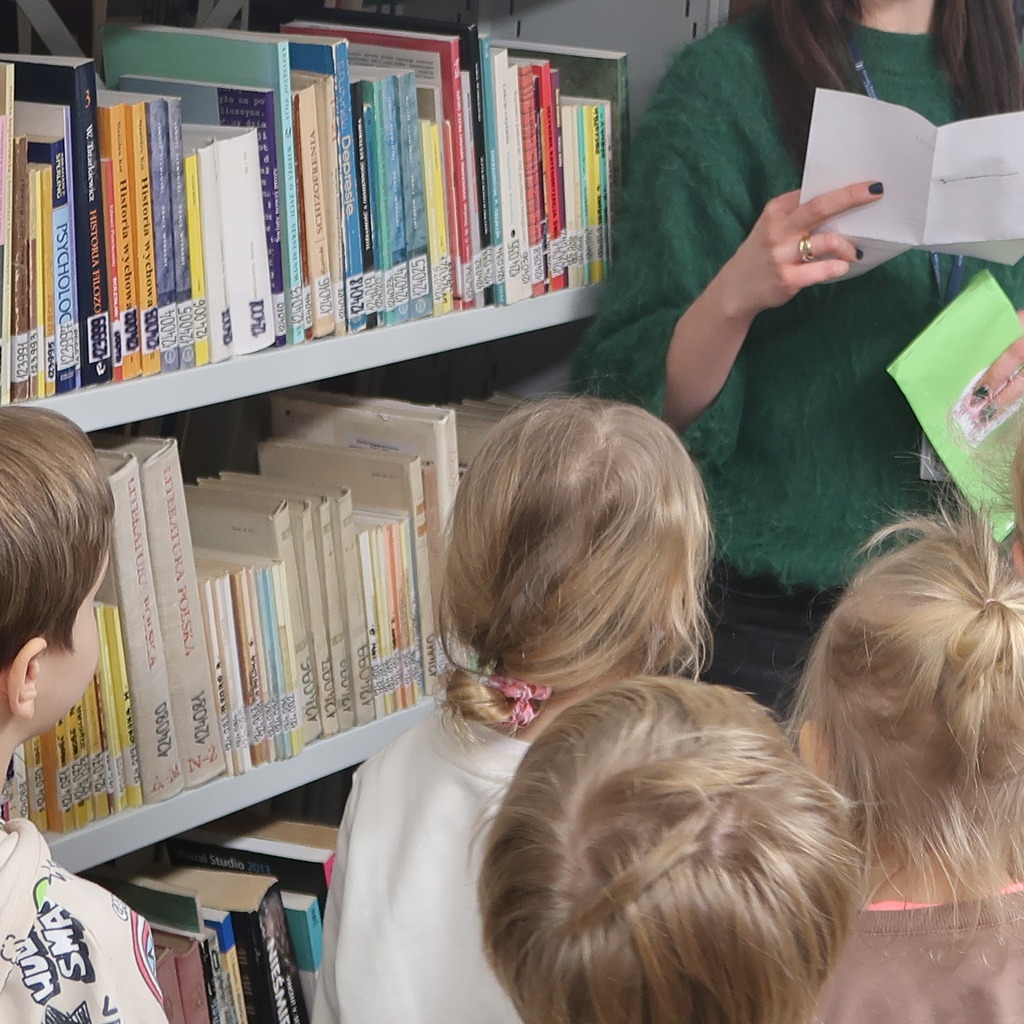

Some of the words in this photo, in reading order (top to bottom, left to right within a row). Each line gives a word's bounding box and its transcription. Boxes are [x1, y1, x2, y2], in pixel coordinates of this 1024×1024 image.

[55, 152, 63, 199] SPERLING
[86, 139, 95, 202] Tatarkiewicz
[308, 129, 323, 235] SCHIZOFRENIA
[340, 134, 354, 217] Depresje
[119, 180, 129, 239] Historia
[141, 177, 150, 237] Historia
[90, 209, 99, 267] HISTORIA
[410, 258, 426, 297] 124025
[508, 240, 520, 278] 124035
[521, 252, 530, 284] 124036
[290, 286, 303, 325] 124013
[317, 278, 333, 315] 124016
[349, 277, 364, 315] 124018
[395, 269, 408, 302] 124024
[161, 310, 176, 349] 124004
[178, 307, 194, 344] 124005
[193, 299, 208, 339] 124006
[277, 303, 285, 332] 124010
[30, 334, 38, 373] 123993
[60, 324, 75, 365] 123997
[91, 317, 107, 359] 123999
[16, 342, 28, 378] 123991
[163, 465, 184, 582] LITERATURA
[177, 586, 196, 658] POLSKA
[357, 644, 374, 706] 124099
[154, 701, 172, 758] 124080
[191, 689, 210, 745] 124081
[209, 854, 245, 871] Studio
